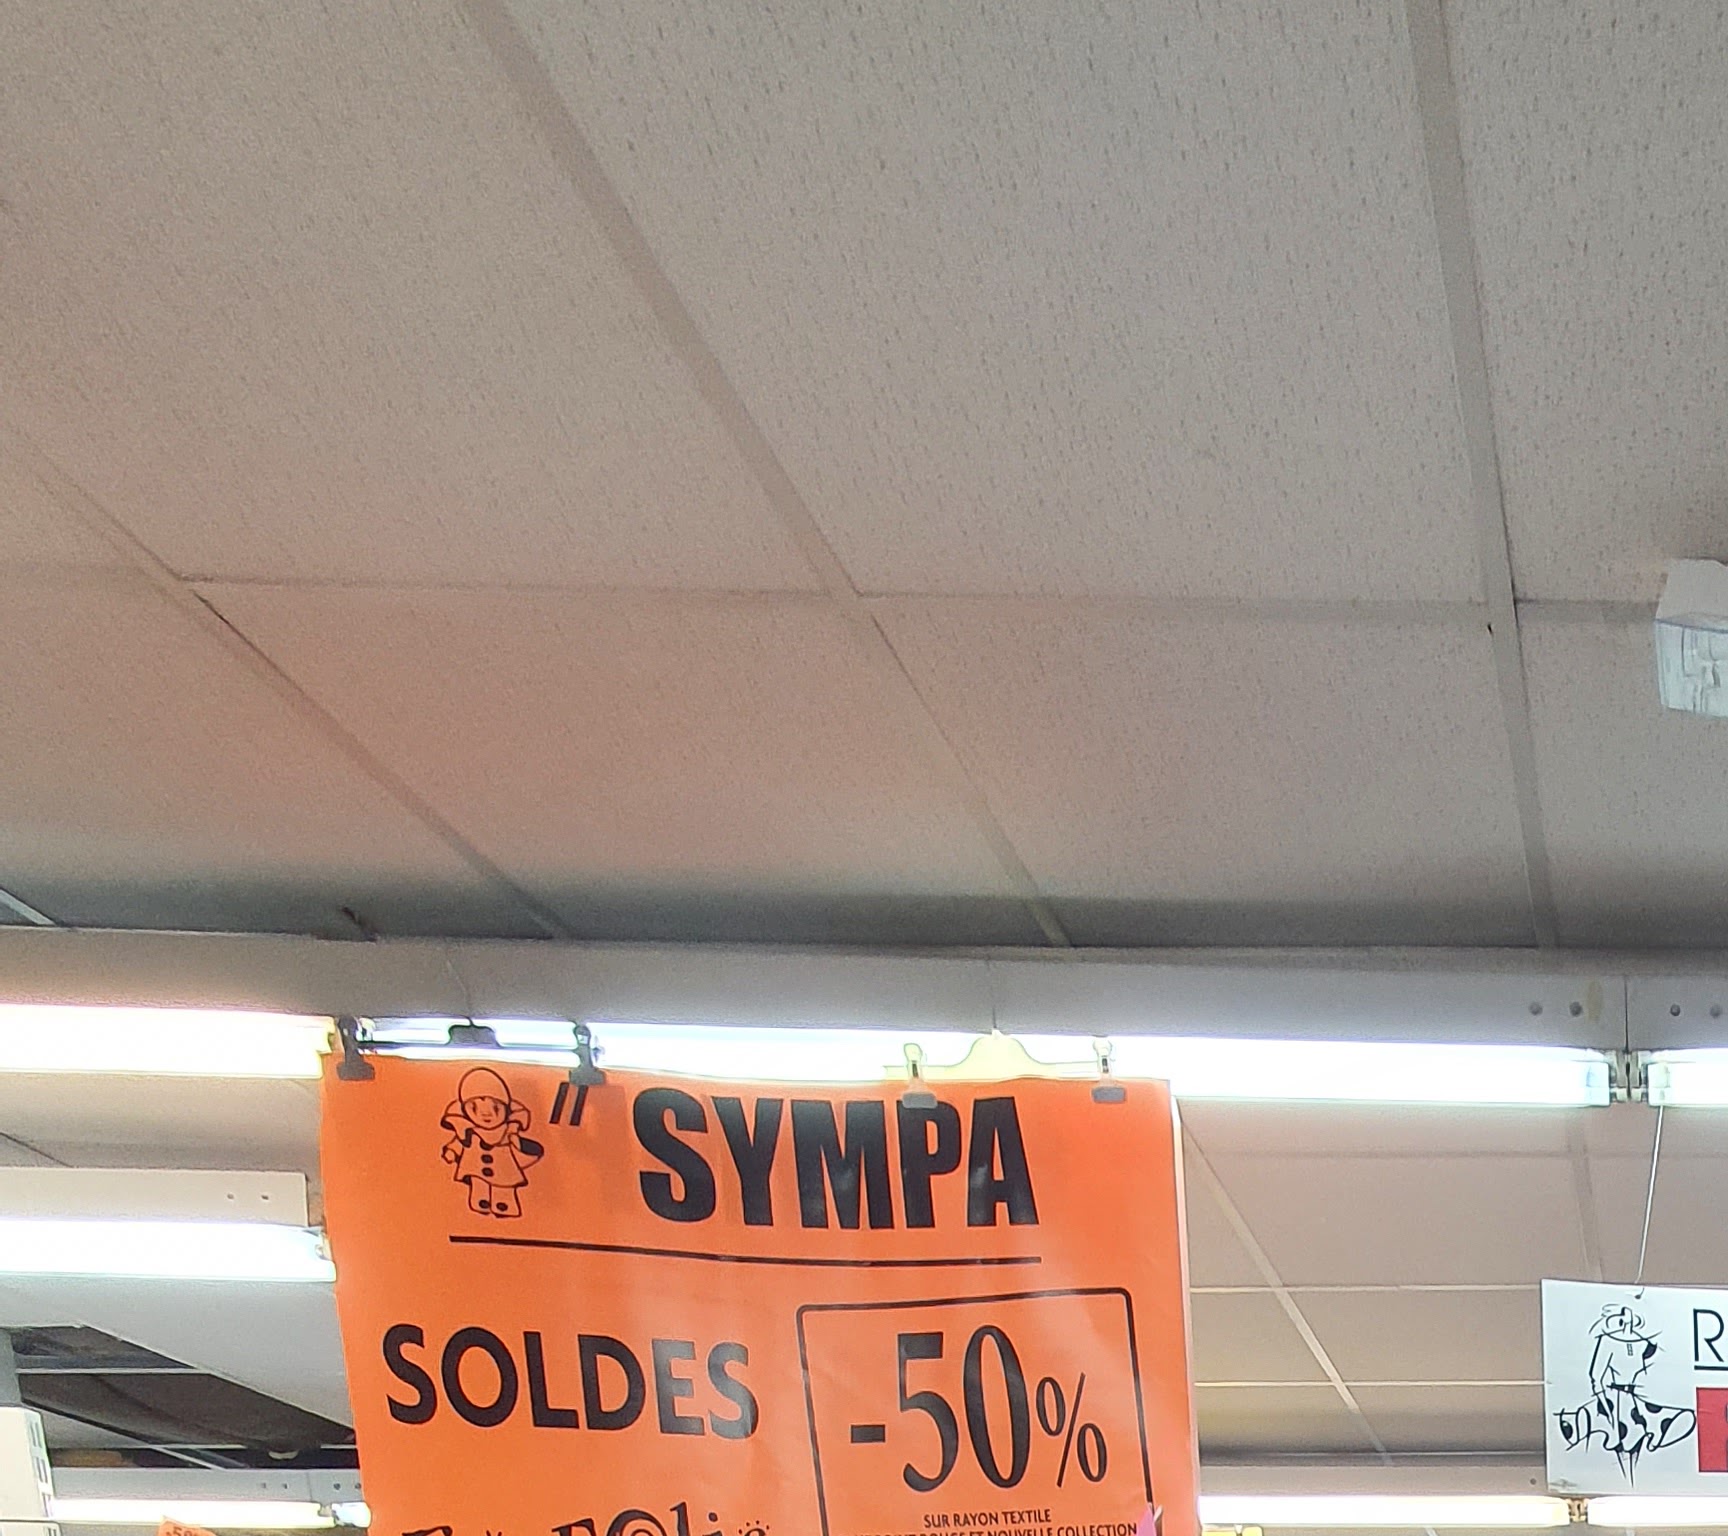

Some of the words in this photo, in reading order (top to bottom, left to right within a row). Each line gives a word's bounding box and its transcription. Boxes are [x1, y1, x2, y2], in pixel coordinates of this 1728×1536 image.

[634, 1087, 1041, 1229] SYMPA
[381, 1322, 759, 1440] SOLDES
[851, 1325, 1107, 1492] -50%
[923, 1514, 950, 1529] SUR
[953, 1512, 999, 1527] RAYON
[1002, 1509, 1051, 1525] TEXTILE
